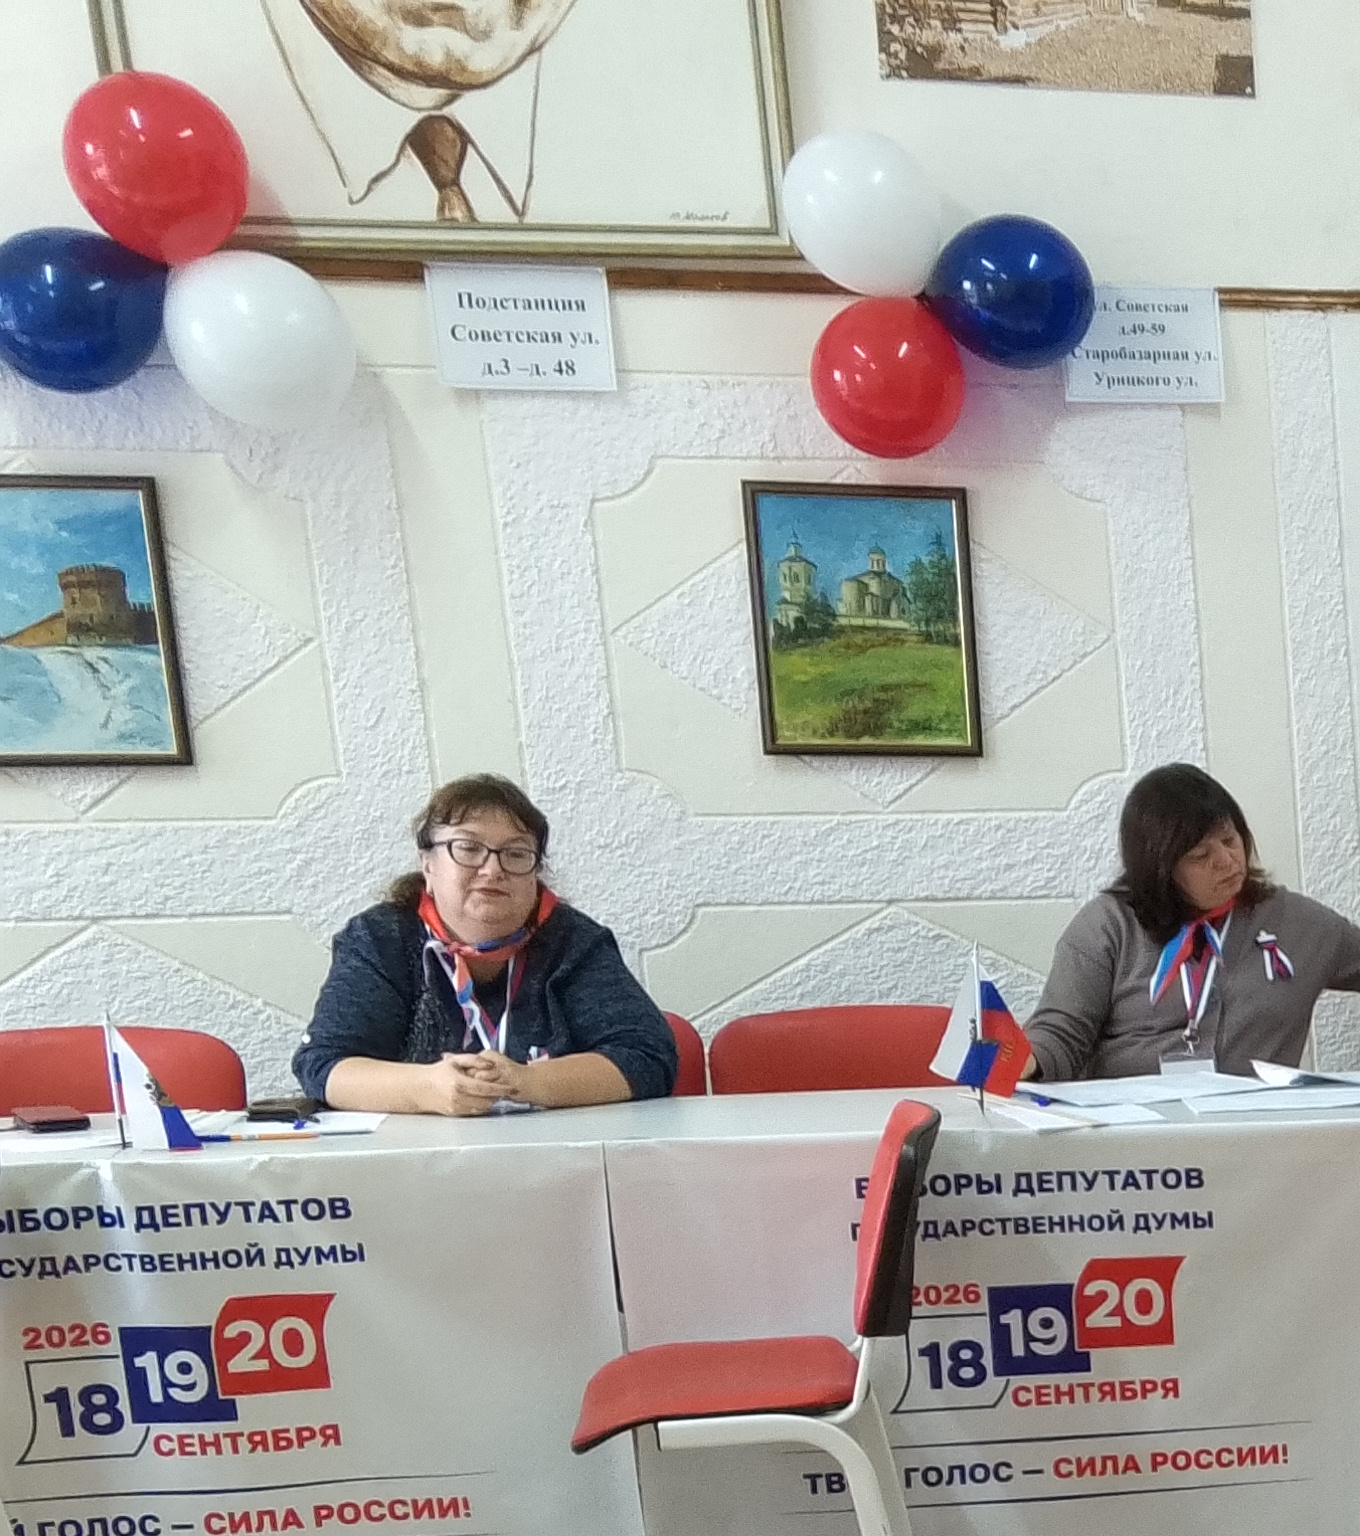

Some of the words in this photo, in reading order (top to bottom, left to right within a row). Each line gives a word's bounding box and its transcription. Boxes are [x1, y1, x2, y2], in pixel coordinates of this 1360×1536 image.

[458, 291, 586, 312] Подстанция
[1116, 299, 1189, 313] Советская
[451, 324, 563, 344] Советская
[569, 332, 600, 348] ул.
[553, 359, 576, 376] 48
[1094, 371, 1171, 389] Урицкого
[1175, 376, 1198, 390] ул.
[1011, 1167, 1205, 1198] ДЕПУТАТОВ
[134, 1197, 352, 1233] ДЕПУТАТОВ
[1132, 1210, 1214, 1235] ДУМЫ
[0, 1242, 266, 1280] СУДАРСТВЕННОЙ
[273, 1242, 366, 1270] ДУМЫ
[911, 1283, 981, 1307] 2026
[22, 1323, 112, 1350] 2026
[917, 1340, 988, 1390] 18
[1000, 1307, 1068, 1356] 19
[1083, 1278, 1165, 1328] 20
[43, 1383, 124, 1438] 18
[134, 1350, 209, 1403] 19
[223, 1316, 317, 1374] 20
[1011, 1378, 1180, 1408] СЕНТЯБРЯ
[153, 1424, 342, 1458] СЕНТЯБРЯ
[903, 1460, 1014, 1490] ГОЛОС
[1053, 1454, 1141, 1480] СИЛА
[1150, 1443, 1290, 1474] РОССИИ!
[204, 1508, 304, 1535] СИЛА
[313, 1497, 472, 1528] РОССИИ!
